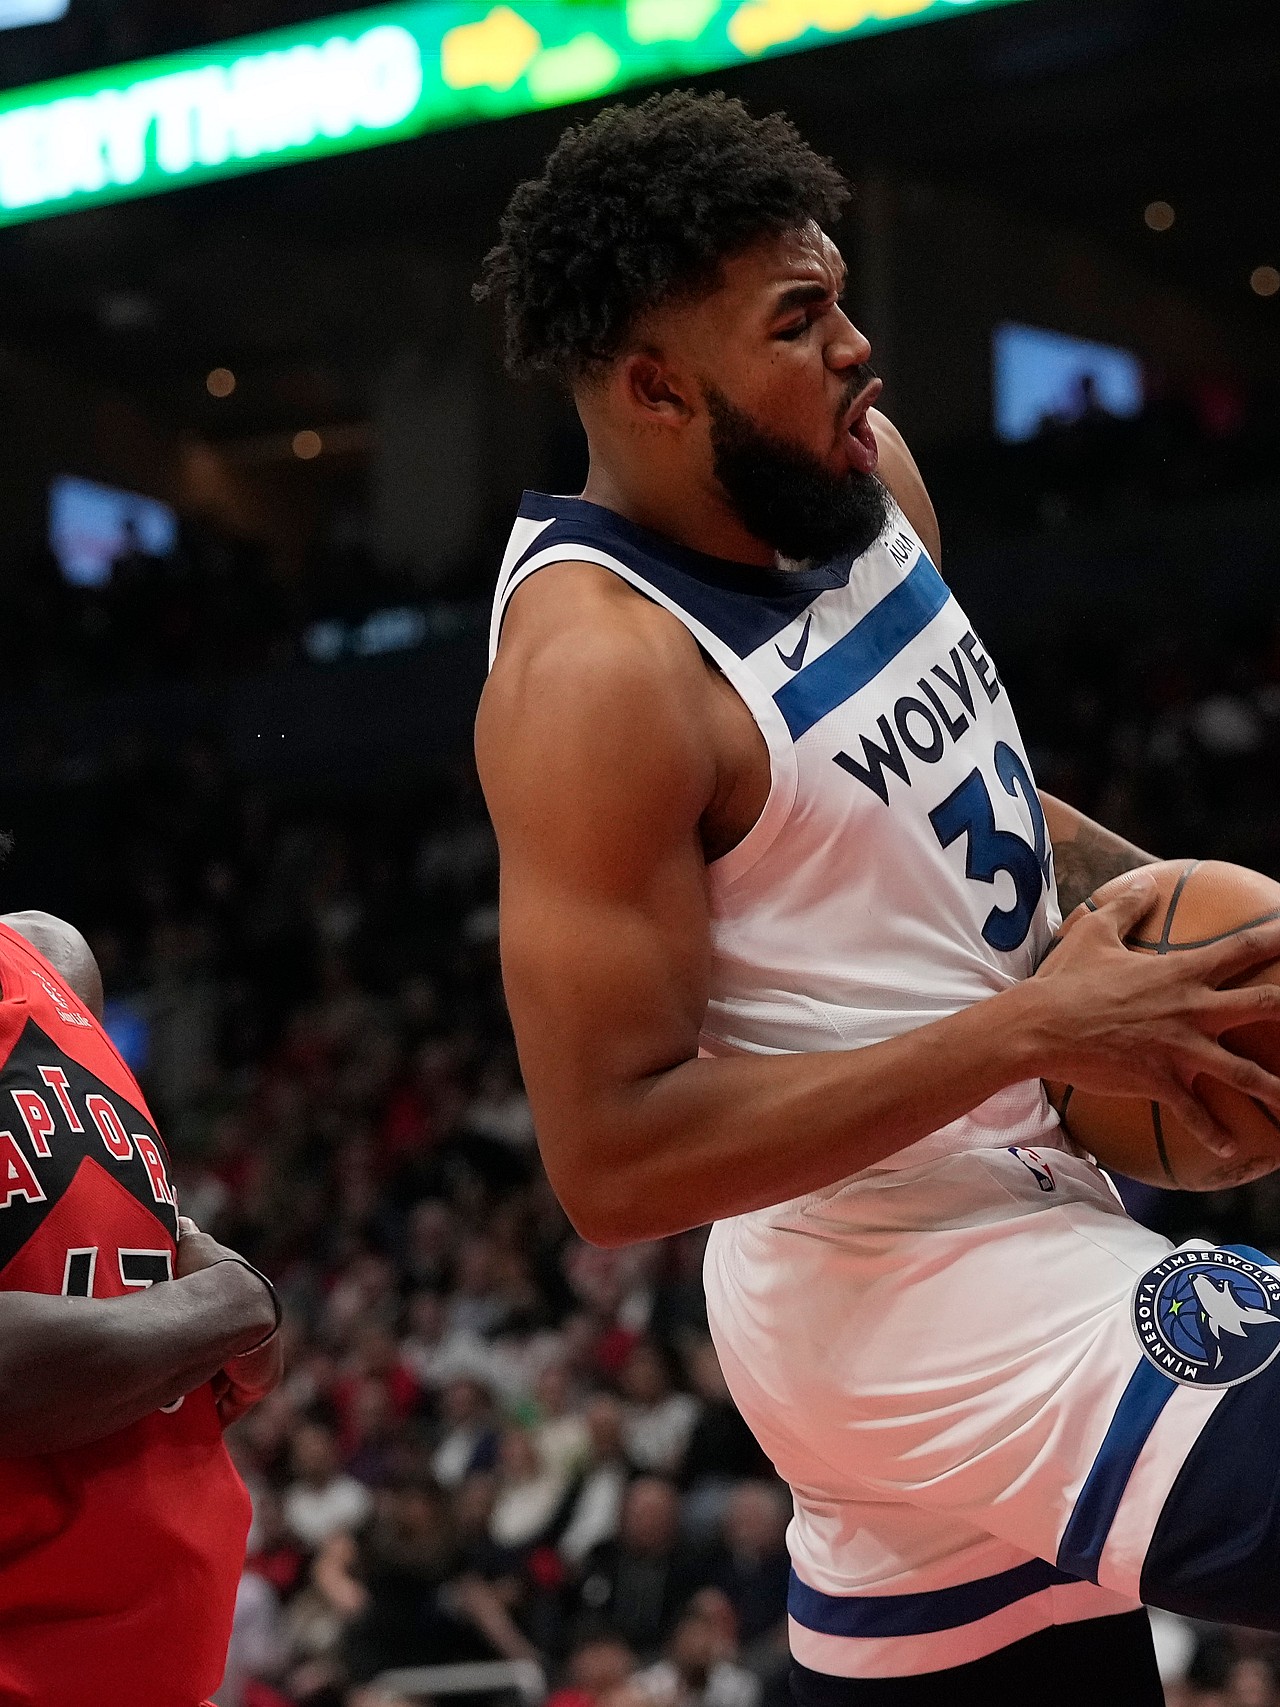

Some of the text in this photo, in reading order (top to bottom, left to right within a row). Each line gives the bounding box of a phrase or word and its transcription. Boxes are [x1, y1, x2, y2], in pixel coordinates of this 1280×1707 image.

[832, 630, 1003, 807] WOLVE
[928, 741, 1052, 952] 32
[1138, 1283, 1198, 1379] MINNESOTA
